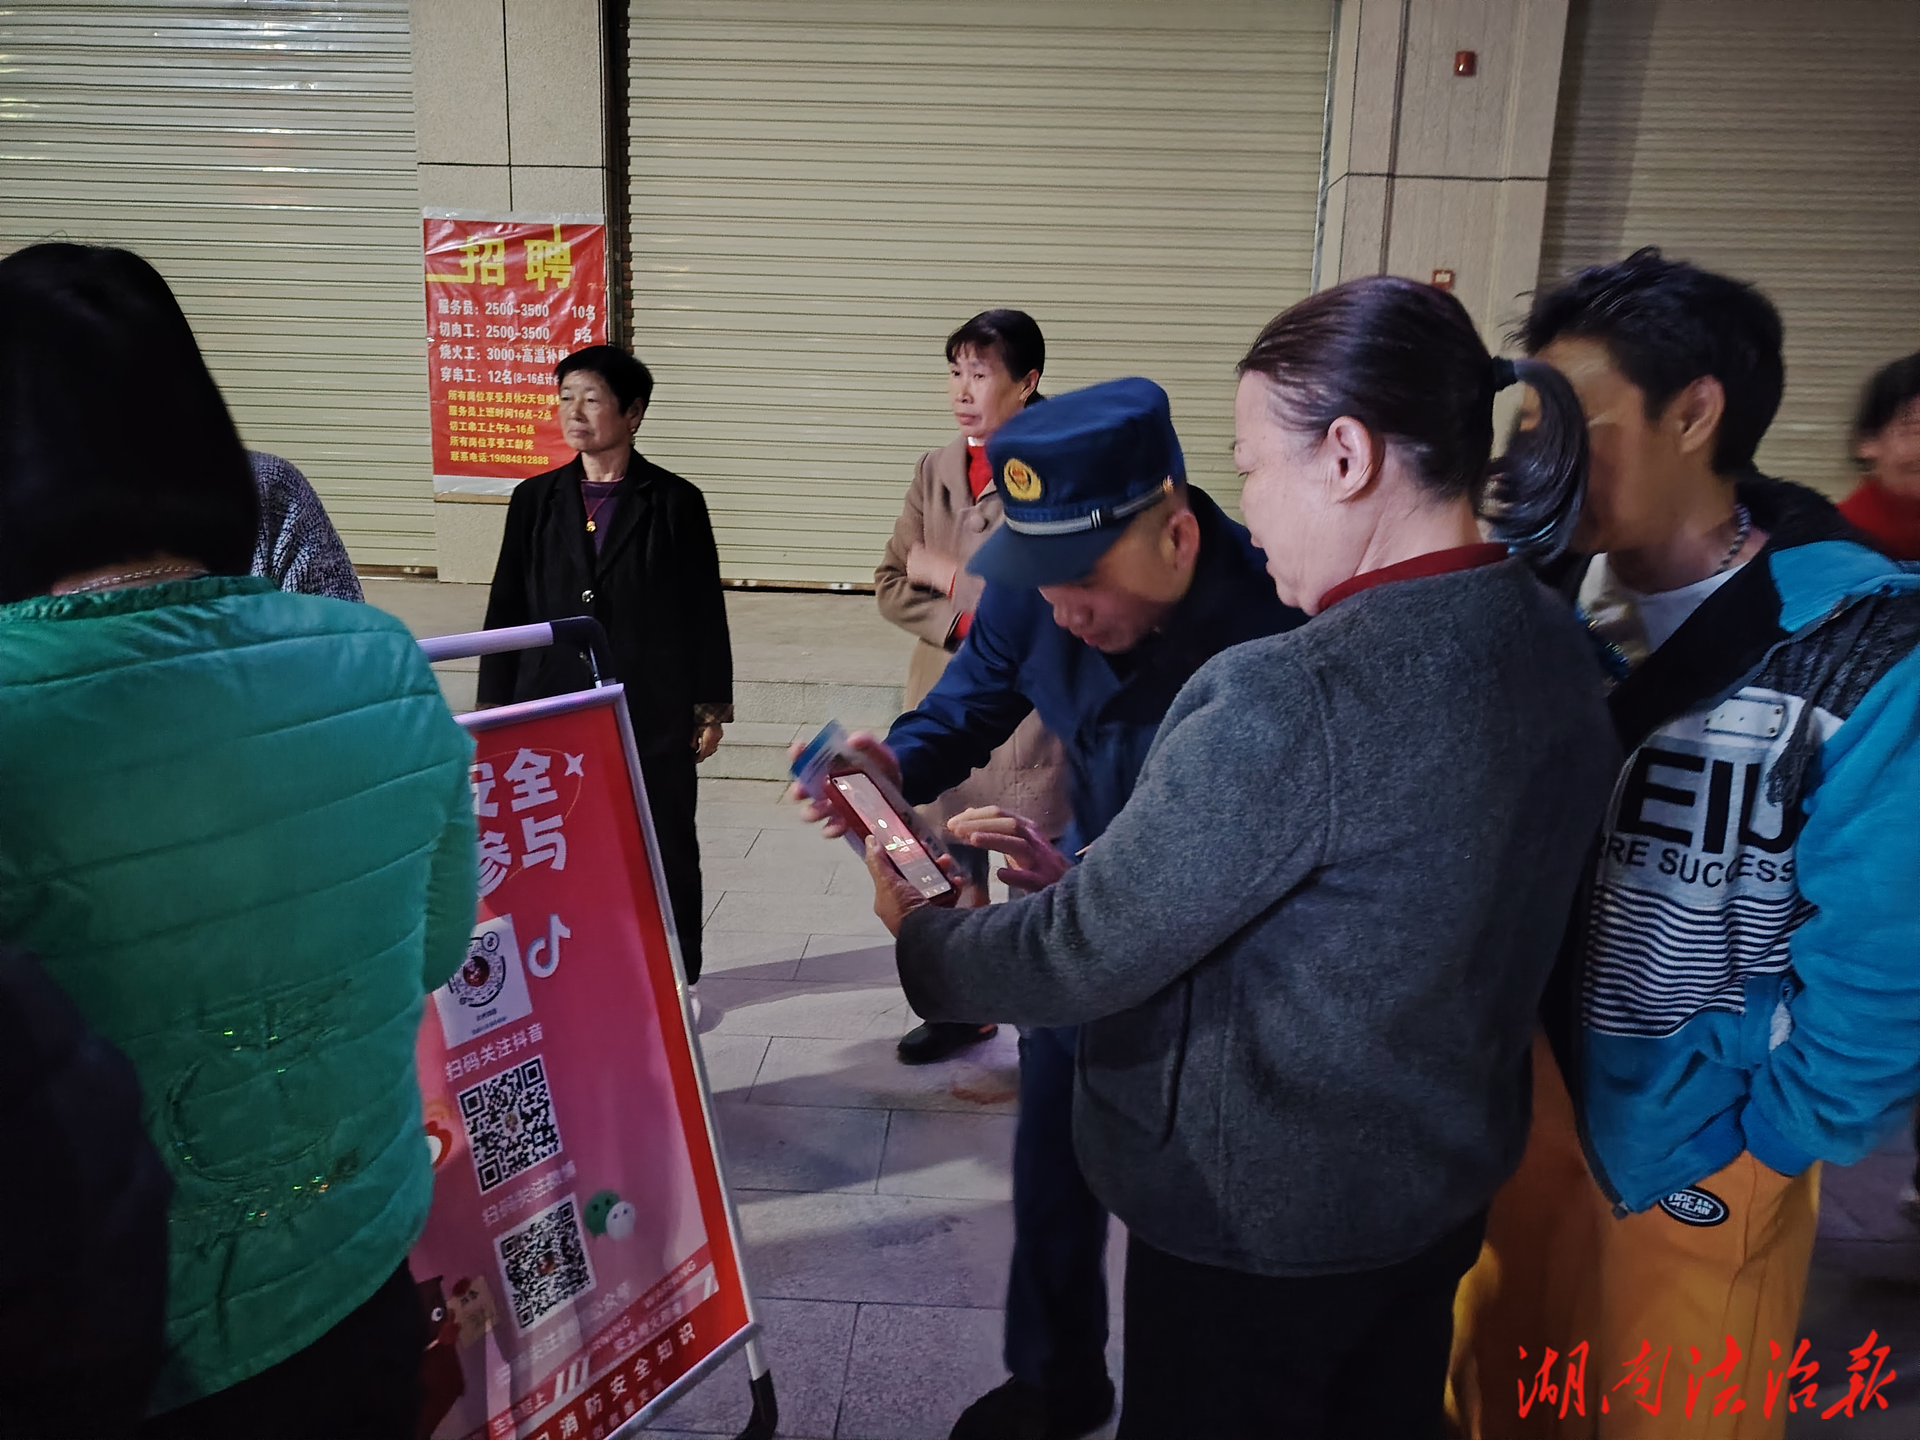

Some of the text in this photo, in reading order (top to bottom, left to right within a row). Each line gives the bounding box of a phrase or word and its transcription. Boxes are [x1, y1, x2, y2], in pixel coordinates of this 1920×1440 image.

[426, 224, 574, 291] 招聘
[571, 304, 597, 321] 10名
[574, 328, 593, 344] 5名
[449, 436, 534, 450] 所有岗位享受工龄奖
[477, 813, 567, 898] 参与
[445, 1022, 543, 1082] 扫码关注抖音
